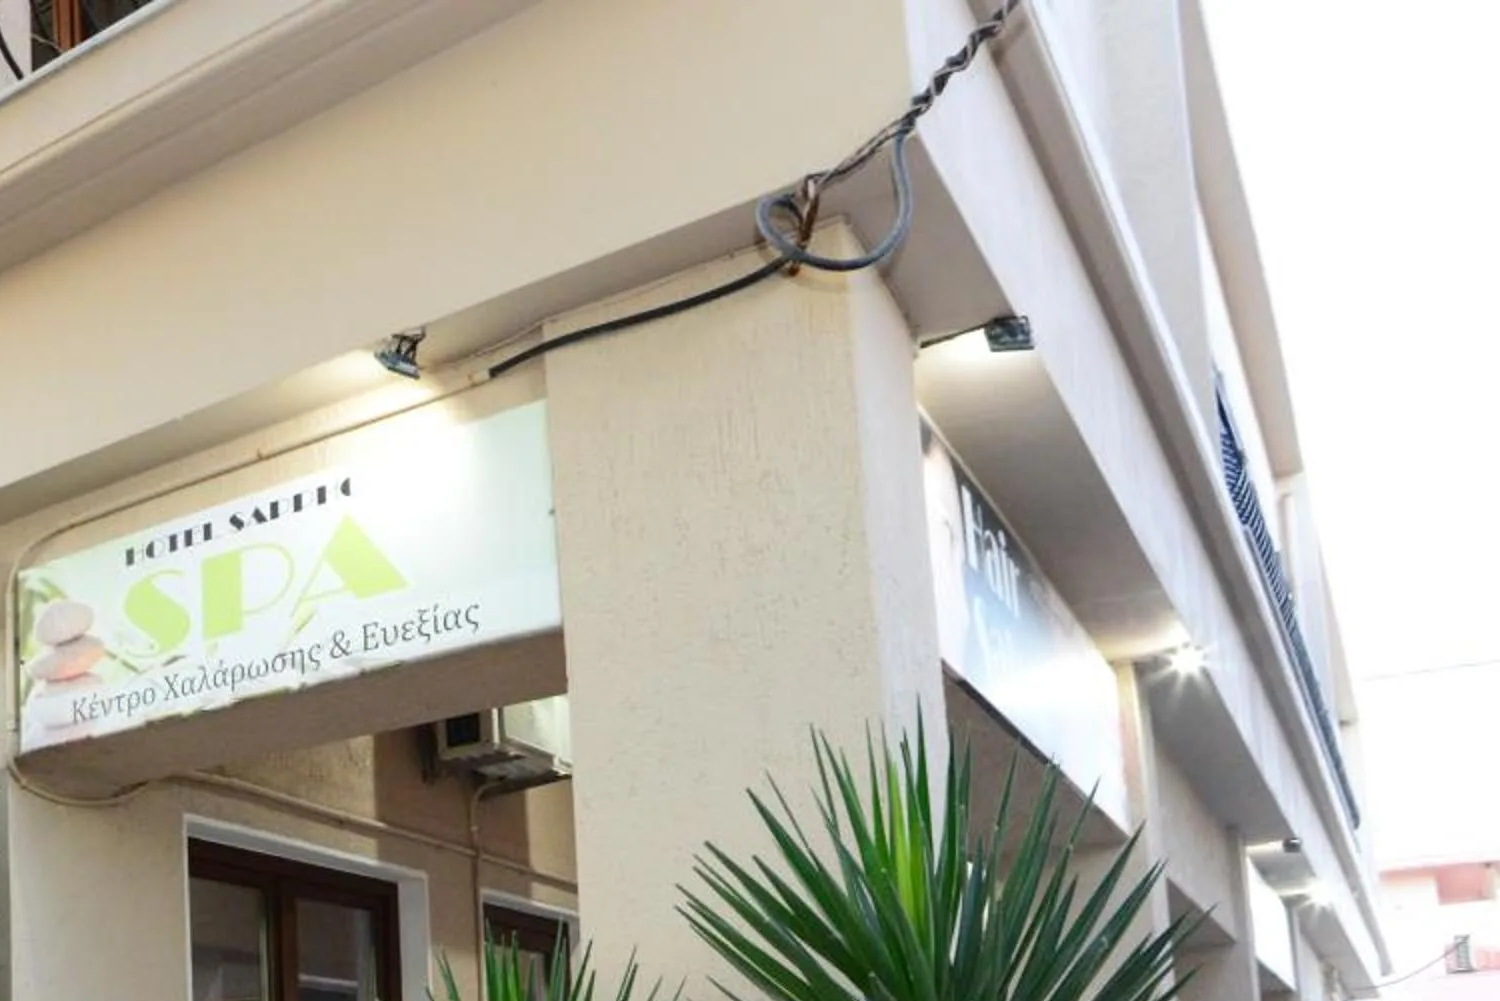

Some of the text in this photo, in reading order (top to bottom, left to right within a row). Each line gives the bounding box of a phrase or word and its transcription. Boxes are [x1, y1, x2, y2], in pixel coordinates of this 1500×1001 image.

[115, 513, 410, 660] SPA
[124, 521, 222, 568] HOTEL
[960, 484, 1022, 619] Hair
[72, 600, 480, 724] Κέντρο Χαλάρωσης & Ευεξίας
